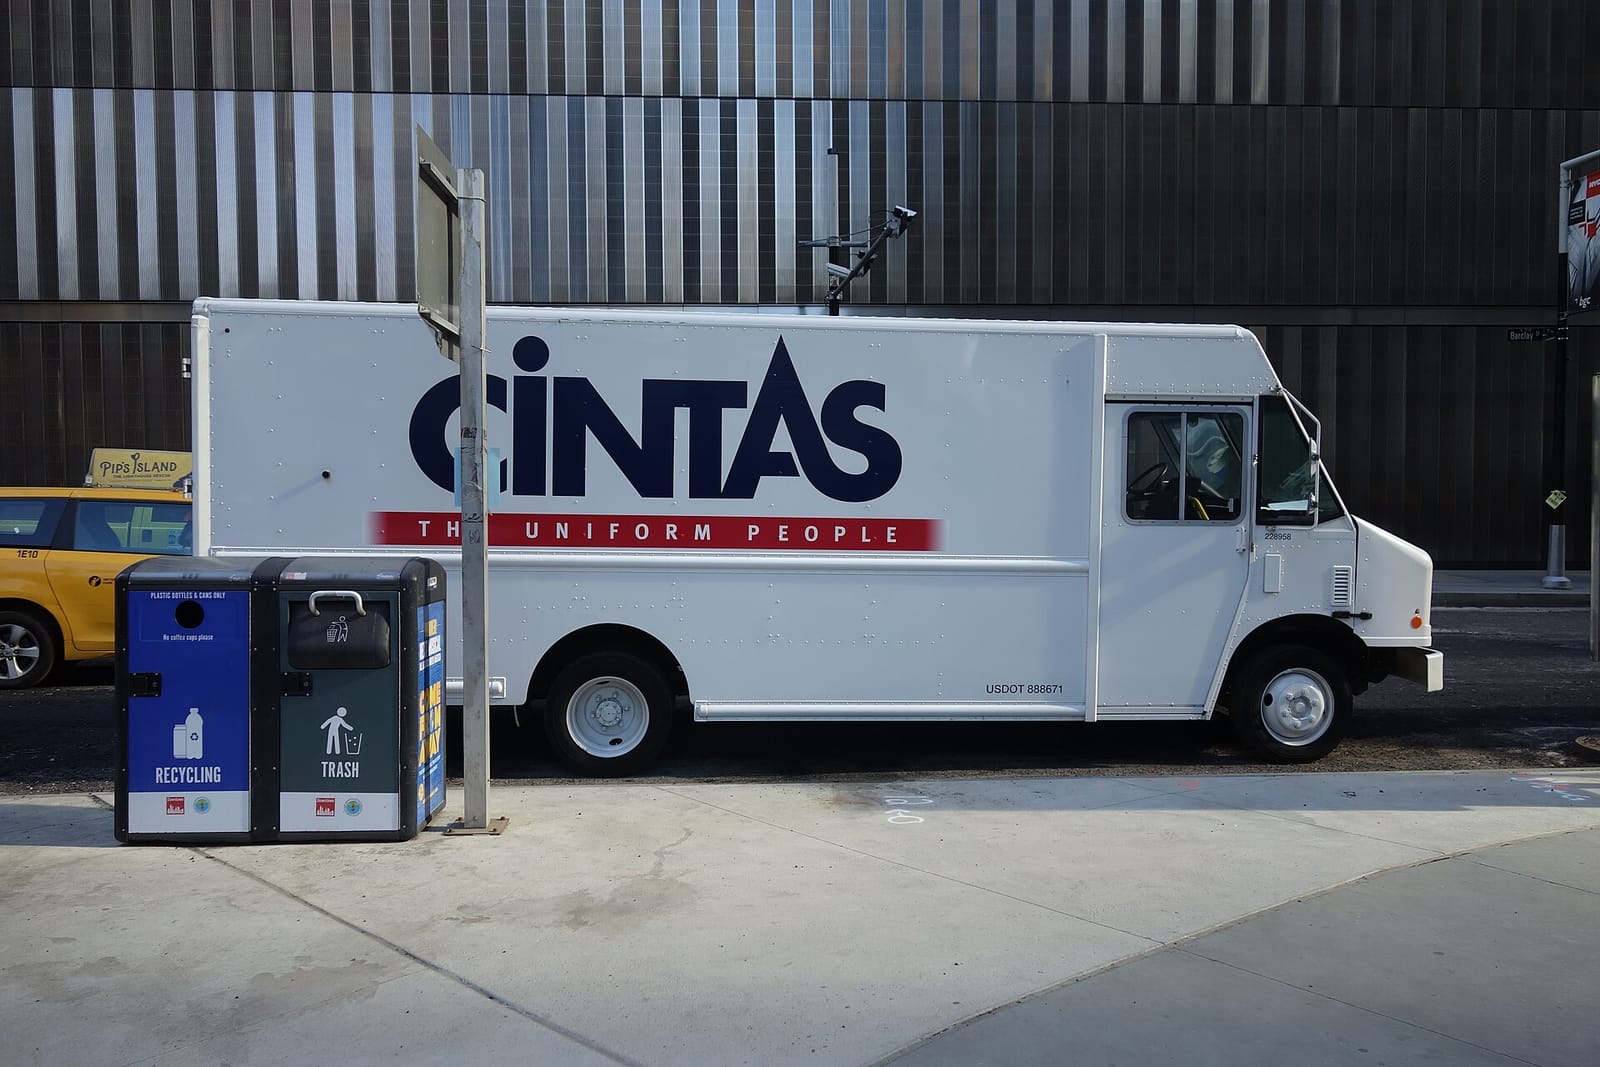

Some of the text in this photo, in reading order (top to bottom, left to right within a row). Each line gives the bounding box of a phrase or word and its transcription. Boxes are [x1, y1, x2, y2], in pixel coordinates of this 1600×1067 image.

[1510, 331, 1534, 342] Barclay
[131, 453, 177, 474] ISLAND
[418, 520, 460, 538] TH
[525, 522, 711, 541] UNIFORM
[747, 525, 897, 543] PEOPLE
[1264, 532, 1292, 541] 228958
[16, 550, 38, 559] 1E10
[213, 591, 226, 599] ONLY
[986, 684, 1063, 694] USDOT 888671
[155, 766, 221, 783] RECYCLING
[321, 761, 359, 778] TRASH
